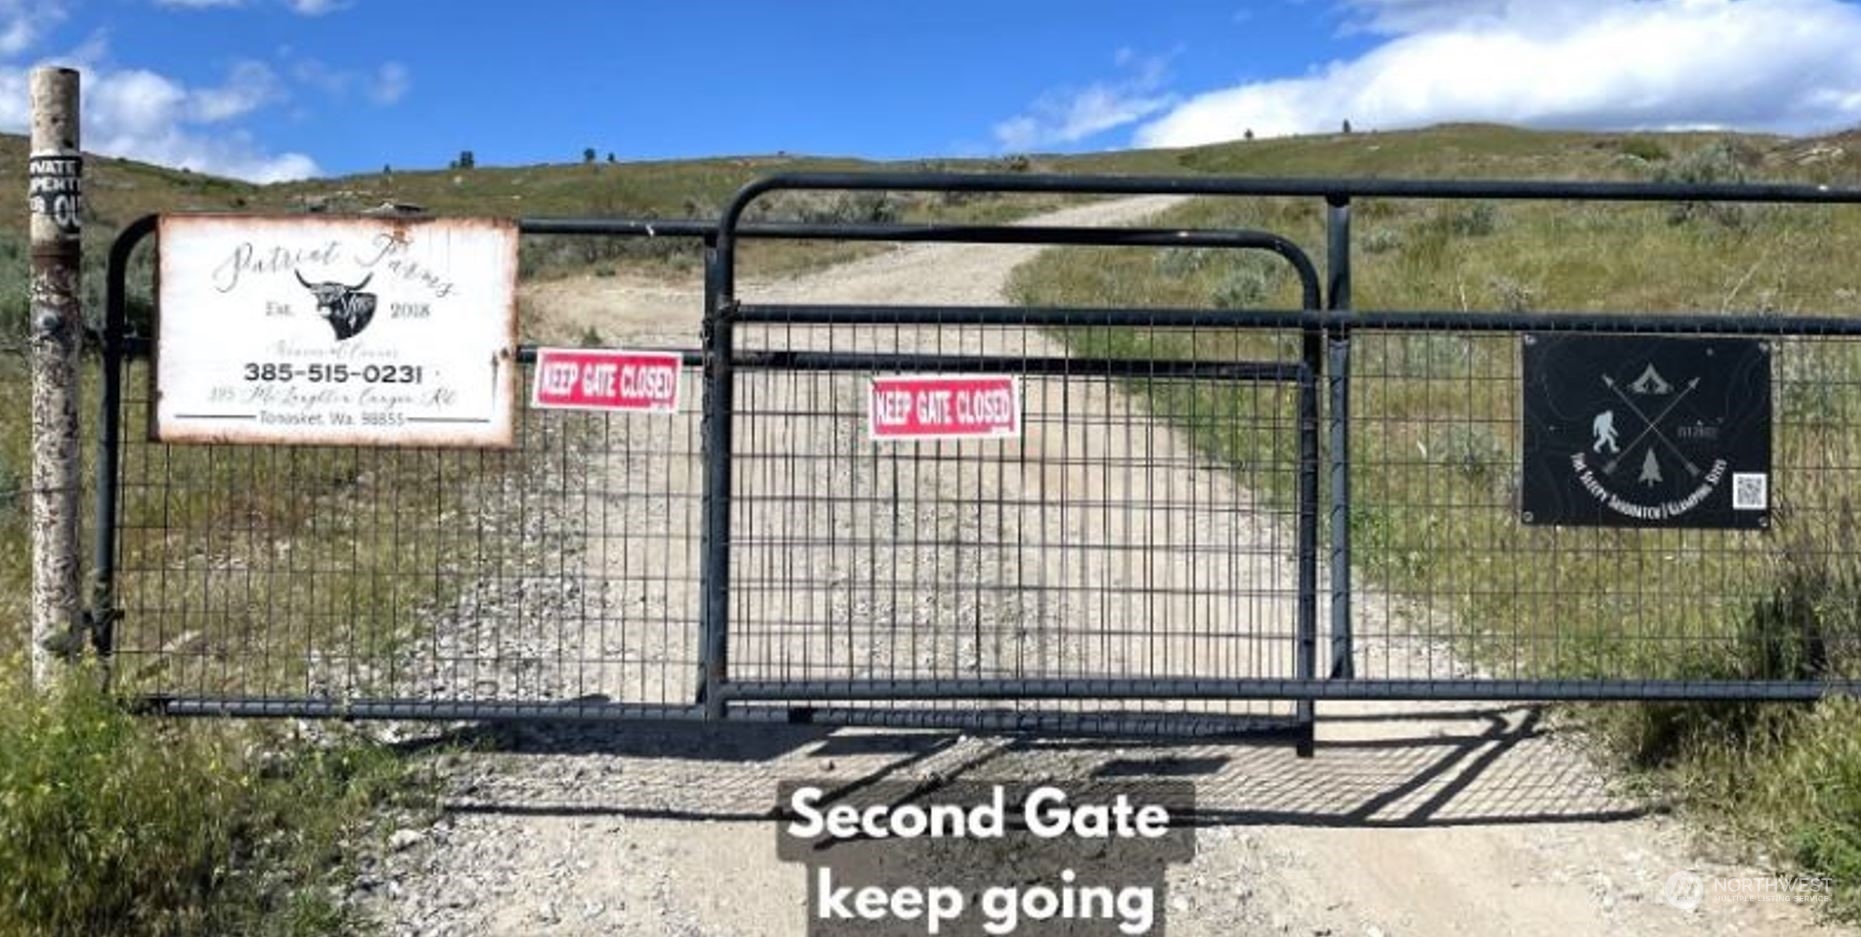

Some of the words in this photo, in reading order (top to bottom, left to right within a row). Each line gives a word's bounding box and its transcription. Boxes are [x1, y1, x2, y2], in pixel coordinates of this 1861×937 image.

[390, 303, 431, 319] 2018
[244, 362, 422, 384] 385-515-0231
[582, 363, 618, 397] GATE
[620, 364, 674, 399] CLOSED
[916, 389, 953, 424] GATE
[956, 388, 1011, 424] CLOSED
